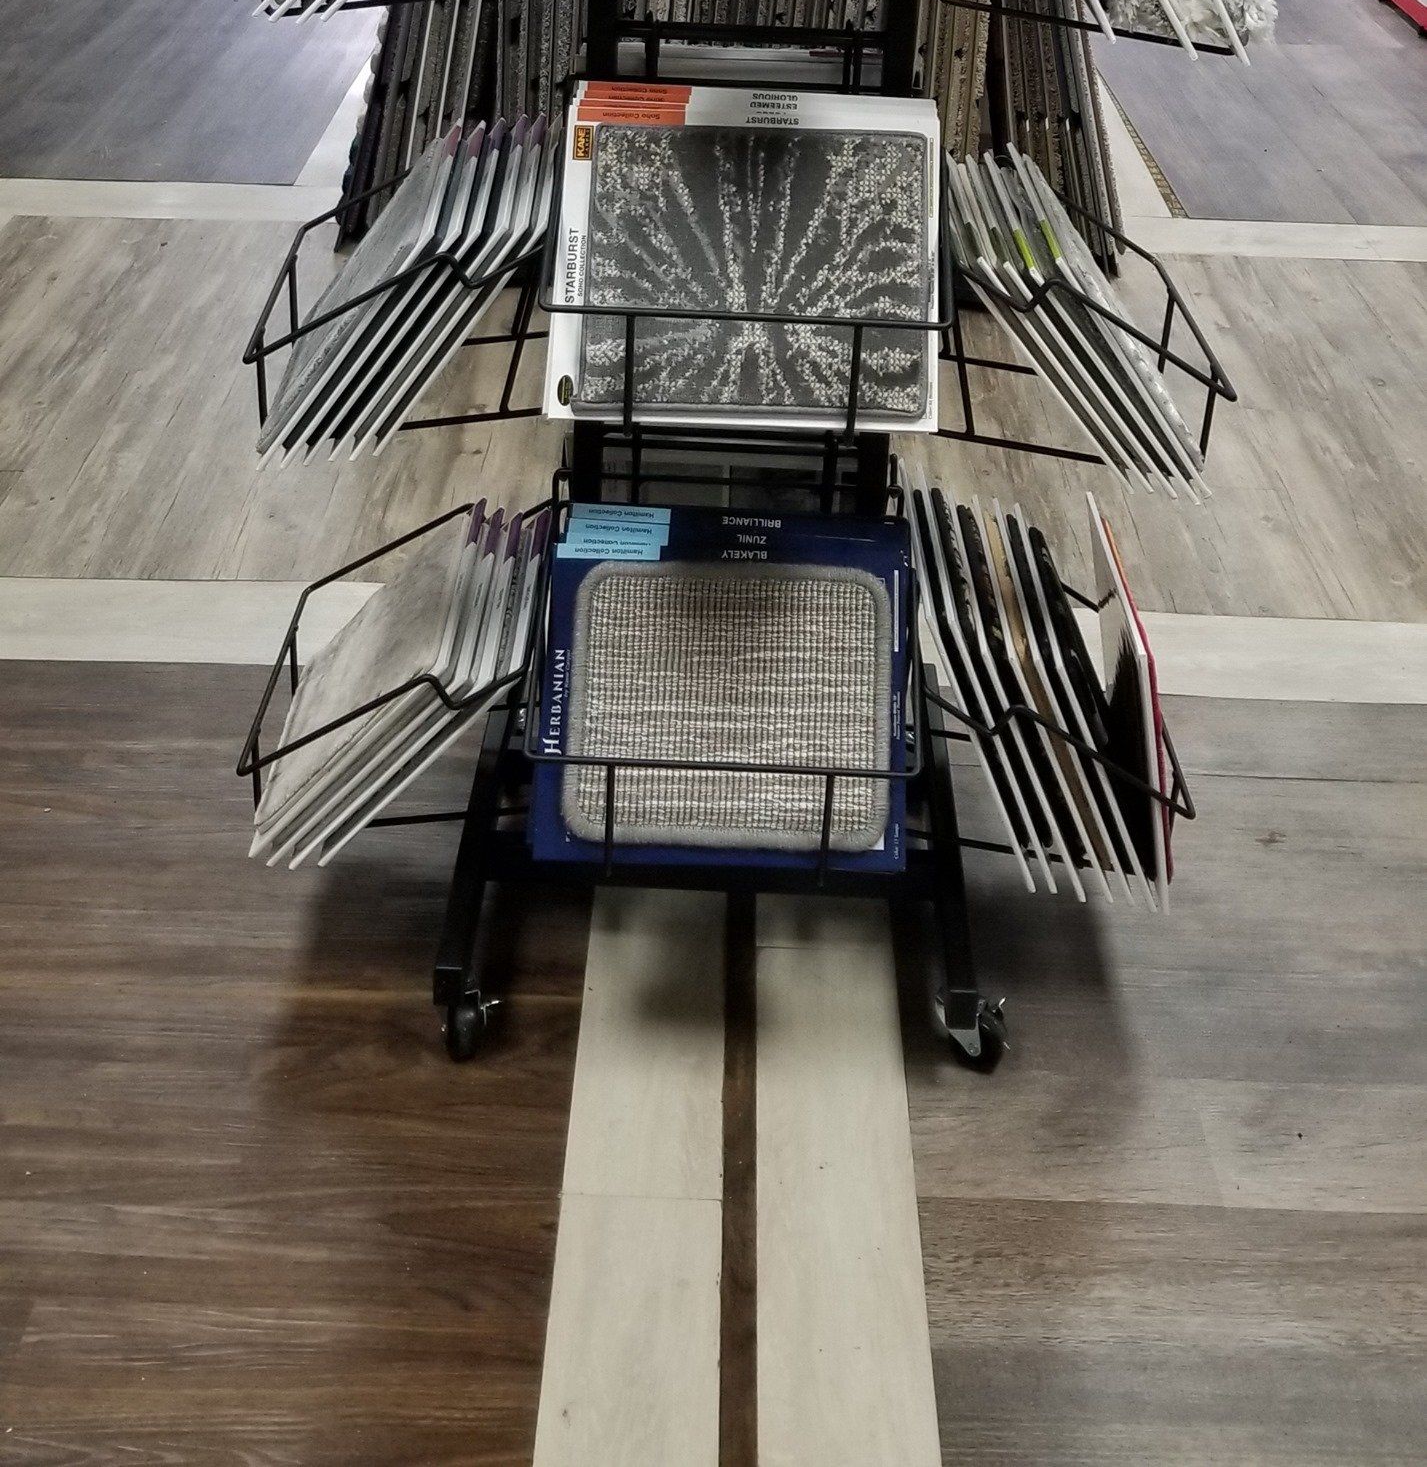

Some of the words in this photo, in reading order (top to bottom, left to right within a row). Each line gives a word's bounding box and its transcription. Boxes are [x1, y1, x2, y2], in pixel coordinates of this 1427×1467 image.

[749, 101, 798, 110] ESTEEMED
[602, 111, 640, 119] Collection
[642, 112, 661, 120] Soho
[745, 116, 799, 125] STARBURST
[577, 127, 587, 158] KANE
[578, 234, 587, 277] COLLECTION
[564, 228, 579, 304] STARBURST
[588, 508, 621, 517] Collection
[624, 511, 655, 519] Hamilton
[722, 516, 781, 528] BRILLIANCE
[585, 523, 619, 532] Collection
[621, 526, 652, 535] Hamilton
[736, 534, 767, 545] ZUNIL
[574, 547, 610, 555] Collection
[612, 548, 643, 556] Hamilton
[721, 550, 768, 560] BLAKELY
[543, 649, 566, 755] HERBANIAN
